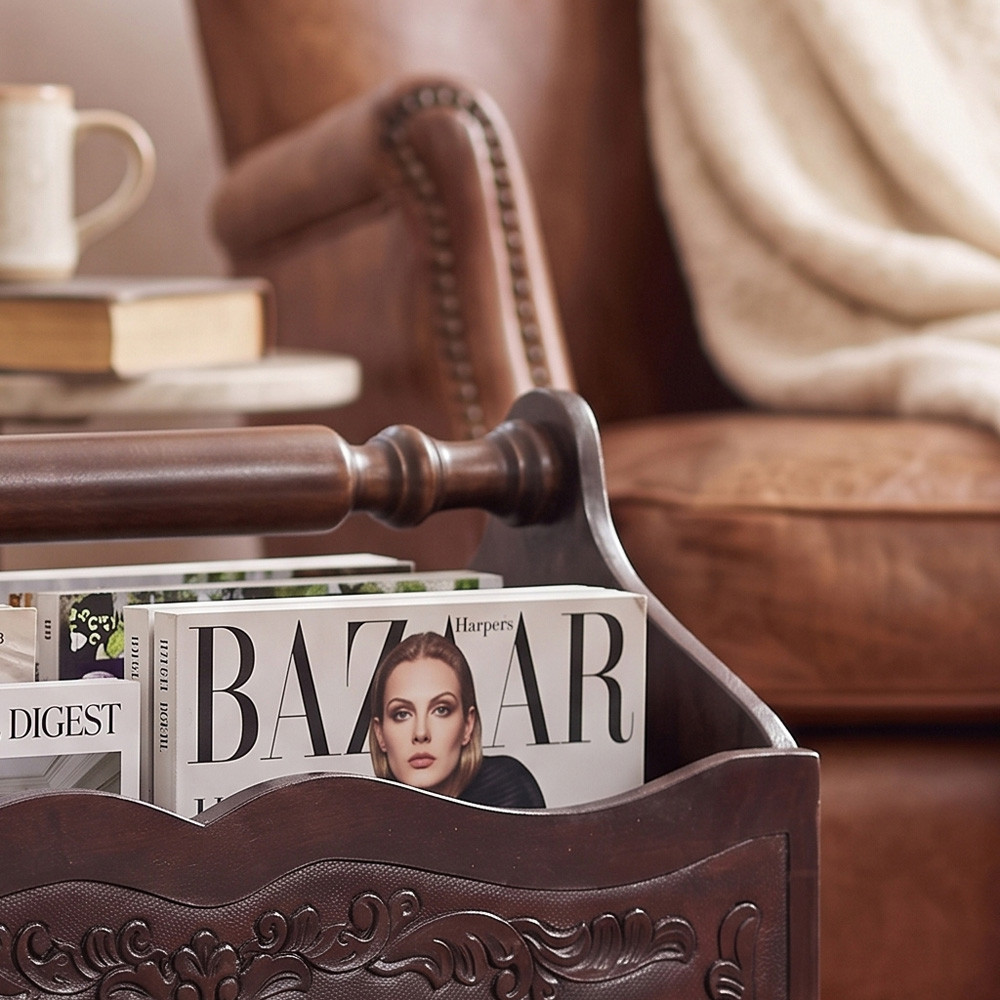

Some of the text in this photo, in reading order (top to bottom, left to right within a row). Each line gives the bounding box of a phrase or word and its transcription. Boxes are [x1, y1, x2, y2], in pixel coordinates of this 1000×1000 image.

[455, 616, 514, 637] Harpers
[187, 611, 634, 764] BAZAR
[8, 702, 122, 740] DIGEST
